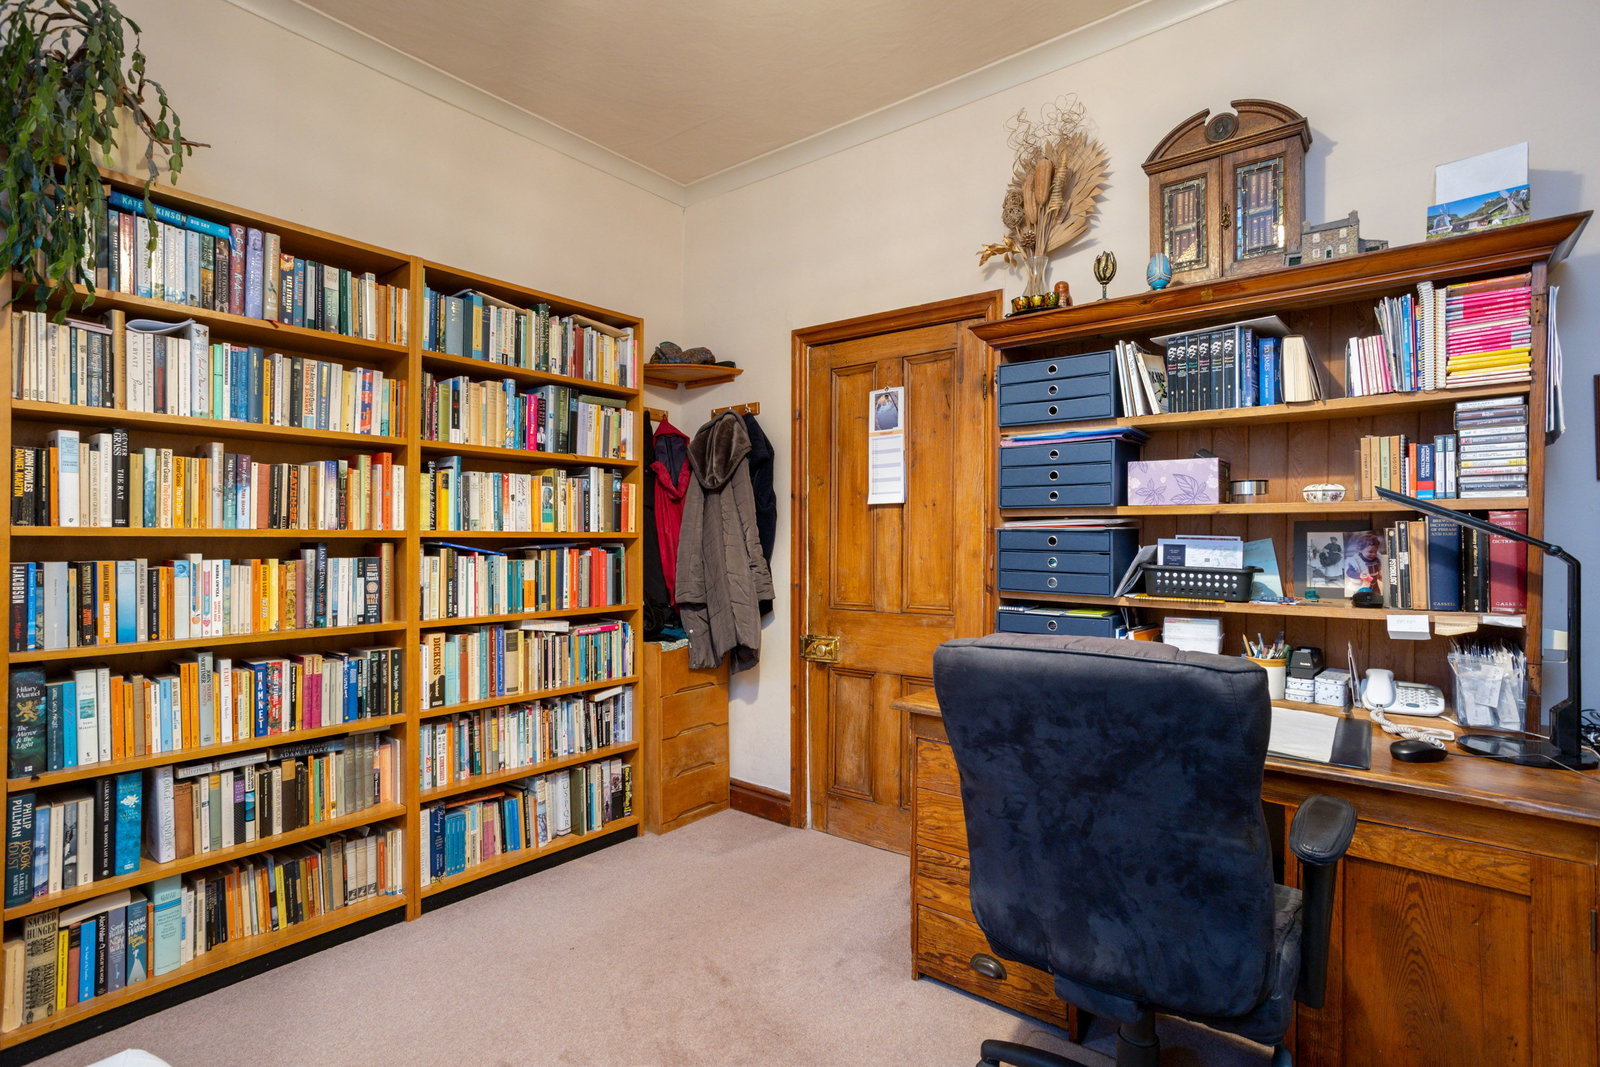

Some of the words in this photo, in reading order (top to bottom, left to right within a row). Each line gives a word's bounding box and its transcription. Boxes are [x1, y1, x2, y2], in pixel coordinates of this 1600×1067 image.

[121, 197, 144, 209] KATE
[254, 251, 262, 269] KATE
[254, 269, 262, 306] ATKINSON
[113, 432, 122, 457] GRASS
[14, 448, 25, 472] DANIEL
[25, 449, 34, 466] JOHN
[163, 450, 171, 469] Günter
[14, 472, 25, 498] MARTIN
[25, 466, 34, 493] FOWLES
[116, 468, 125, 484] THE
[163, 469, 171, 484] Grass
[116, 485, 125, 501] RAT
[12, 570, 25, 604] JACOBSON
[433, 637, 441, 676] DICKENS
[163, 769, 174, 800] GEORGE
[11, 799, 23, 839] PULLMAN
[22, 802, 33, 829] PHILIP
[434, 809, 445, 832] Belonging
[163, 810, 174, 852] SAUNDERS
[20, 839, 33, 870] BOOK
[26, 922, 57, 940] HUNGER
[27, 911, 57, 928] SACRED
